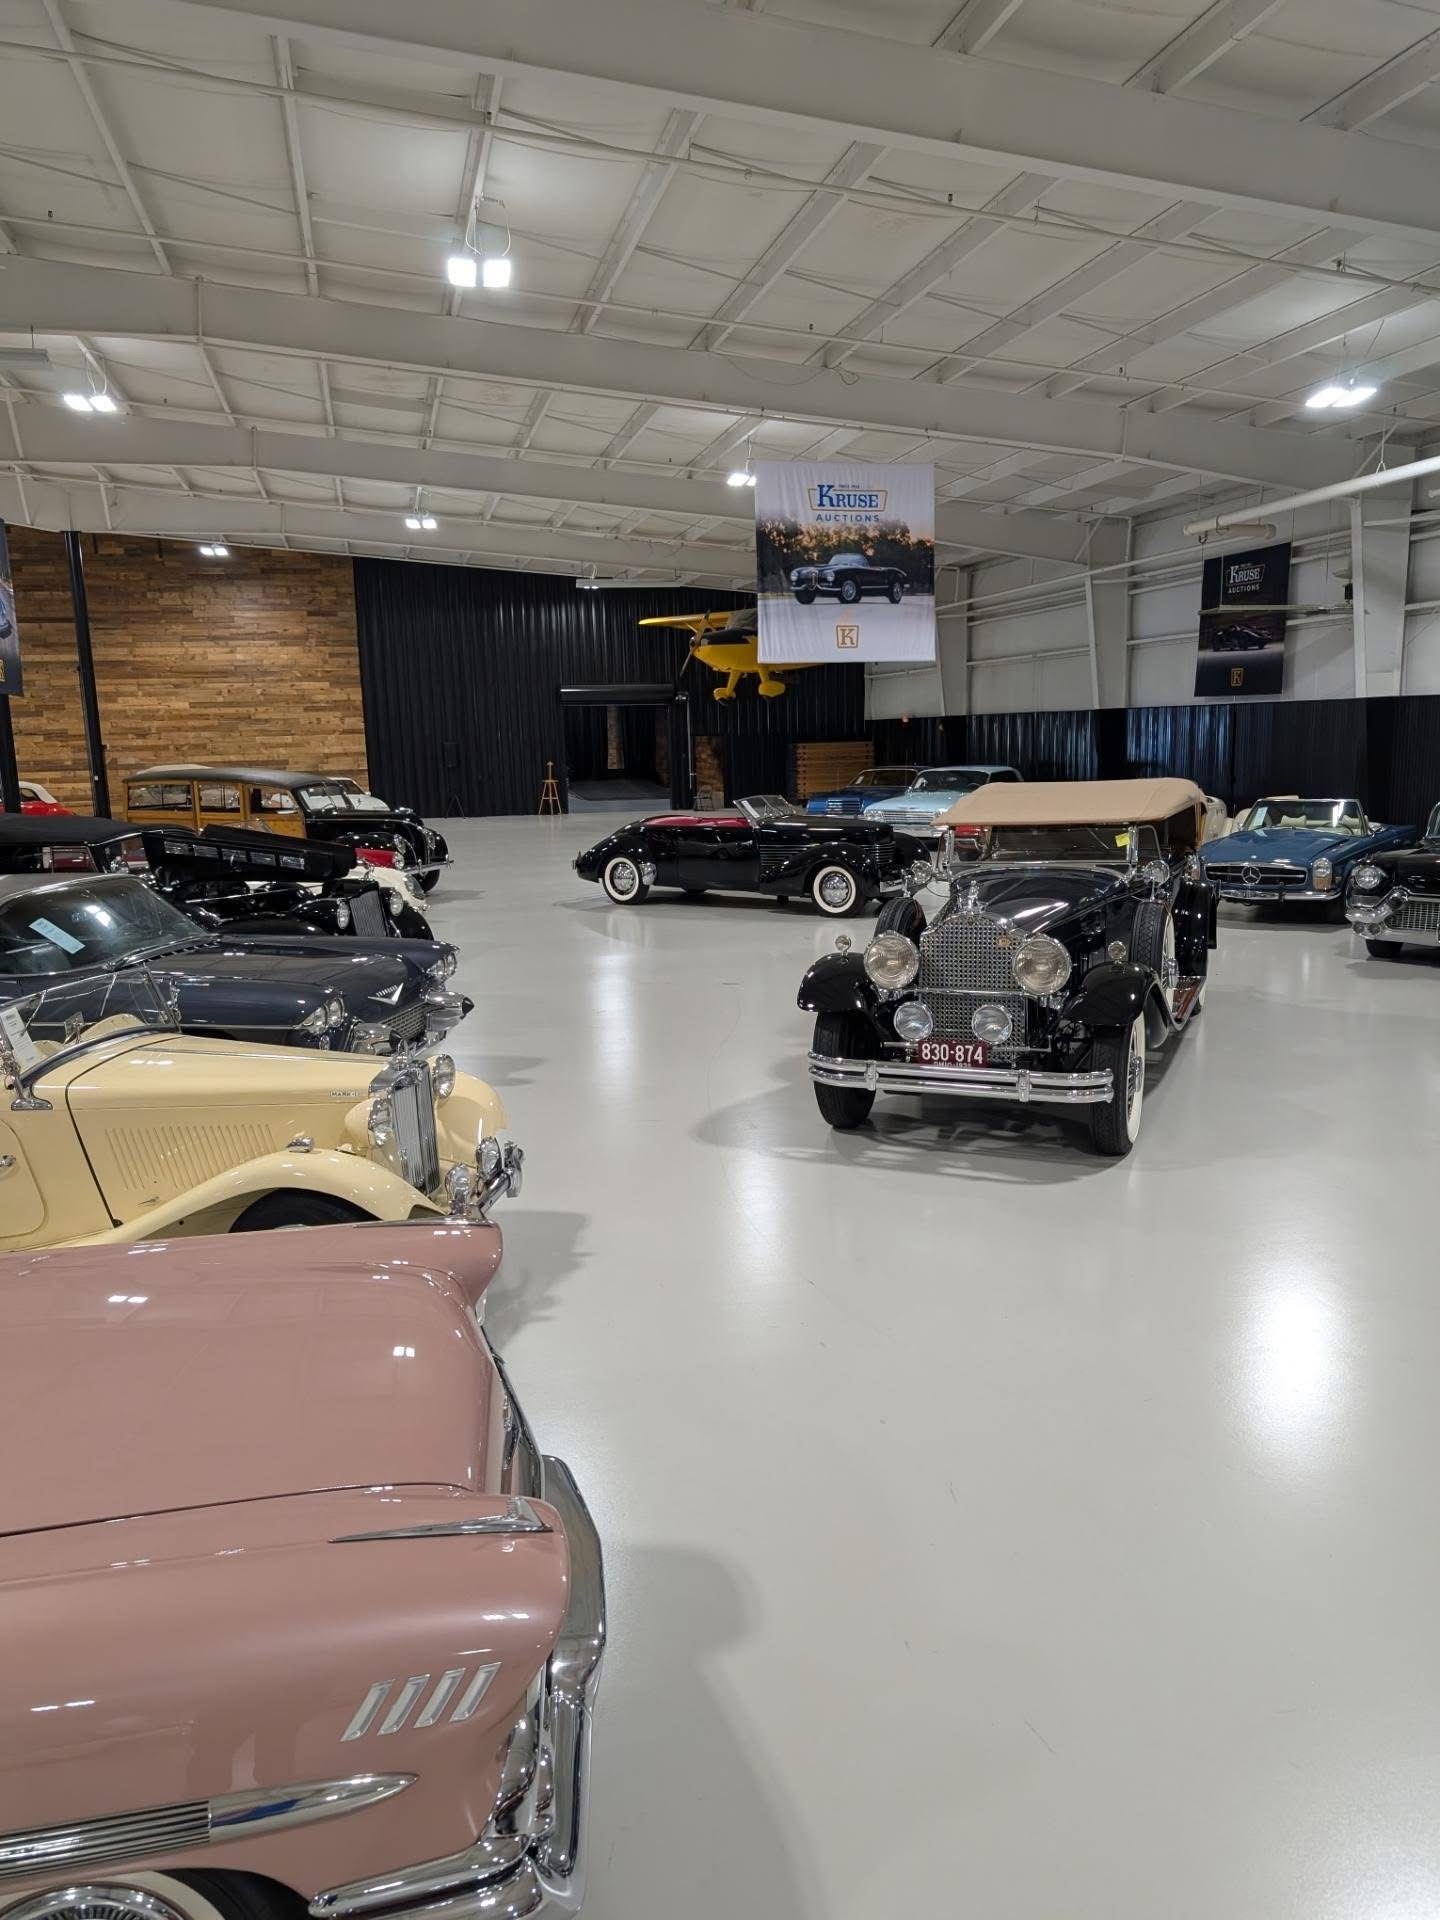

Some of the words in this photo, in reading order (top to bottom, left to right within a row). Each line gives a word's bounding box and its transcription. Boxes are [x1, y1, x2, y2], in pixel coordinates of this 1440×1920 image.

[817, 484, 879, 508] KRUSE
[816, 514, 880, 523] AUCTIONS
[1230, 565, 1260, 583] KRUSE
[1228, 584, 1260, 593] AUCTIONS
[839, 628, 856, 646] K
[921, 1043, 983, 1064] 830-874
